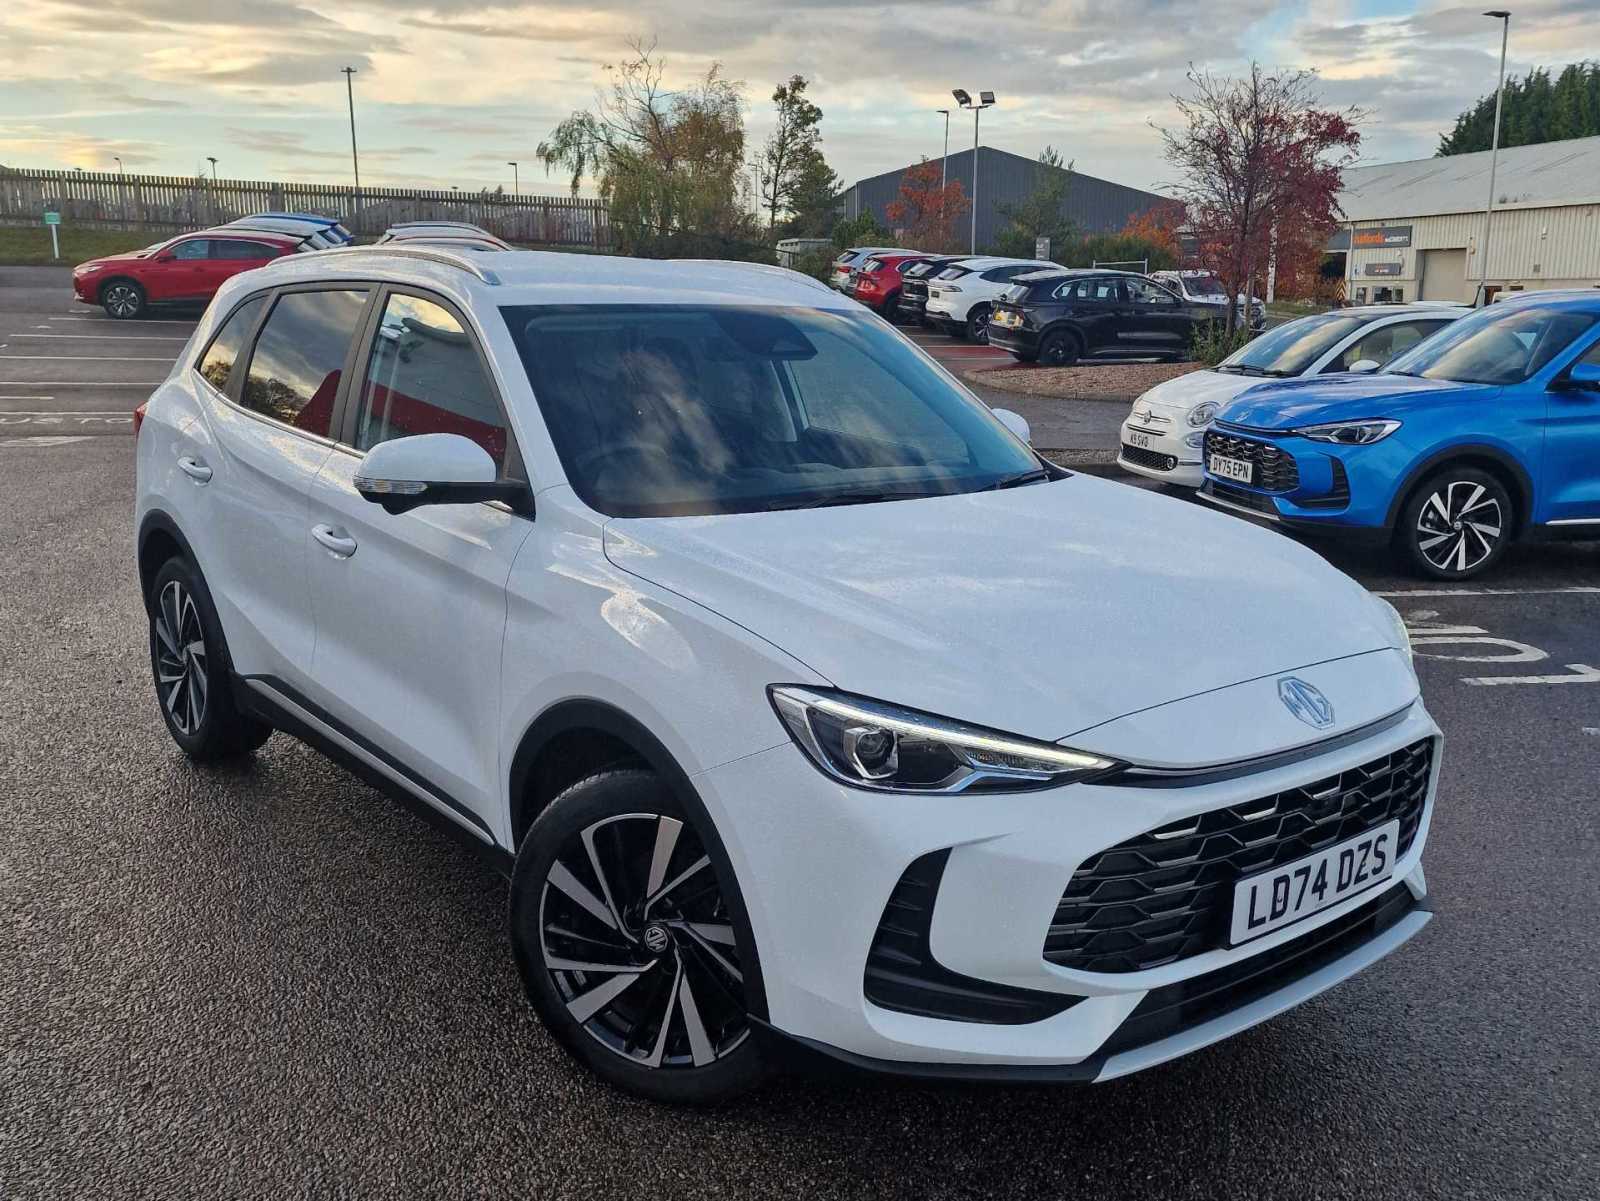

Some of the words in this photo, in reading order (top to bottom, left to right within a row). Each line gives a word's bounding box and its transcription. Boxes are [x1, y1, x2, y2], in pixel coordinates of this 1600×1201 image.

[1213, 457, 1232, 474] DY75
[1233, 462, 1249, 479] EPN
[1279, 677, 1333, 728] MG
[1248, 859, 1328, 930] LD74
[1336, 834, 1389, 893] DZS
